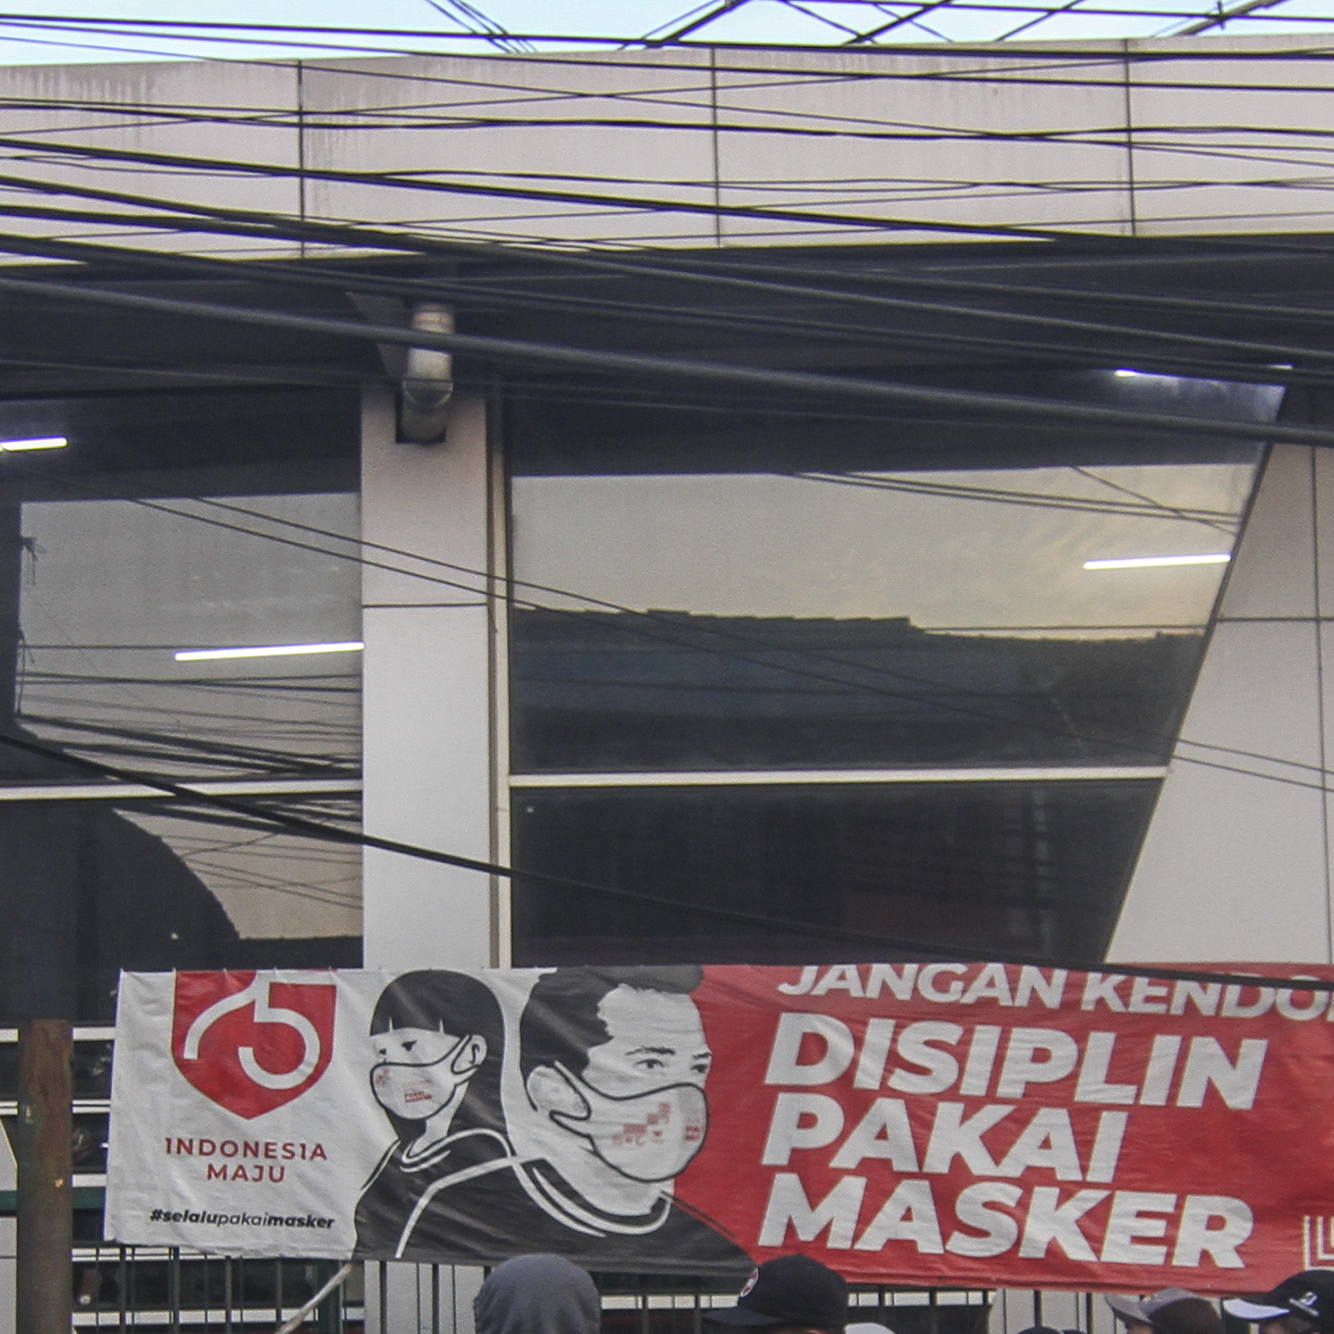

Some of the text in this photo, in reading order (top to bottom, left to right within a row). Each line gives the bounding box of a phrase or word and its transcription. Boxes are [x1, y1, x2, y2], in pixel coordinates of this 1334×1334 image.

[777, 962, 1068, 1010] JANGAN
[764, 1011, 1268, 1110] DISIPLIN
[760, 1092, 1128, 1183] PAKAI
[206, 1163, 285, 1183] MAJU
[149, 1208, 335, 1230] #selalupakaimasker
[757, 1172, 1254, 1270] MASKER
